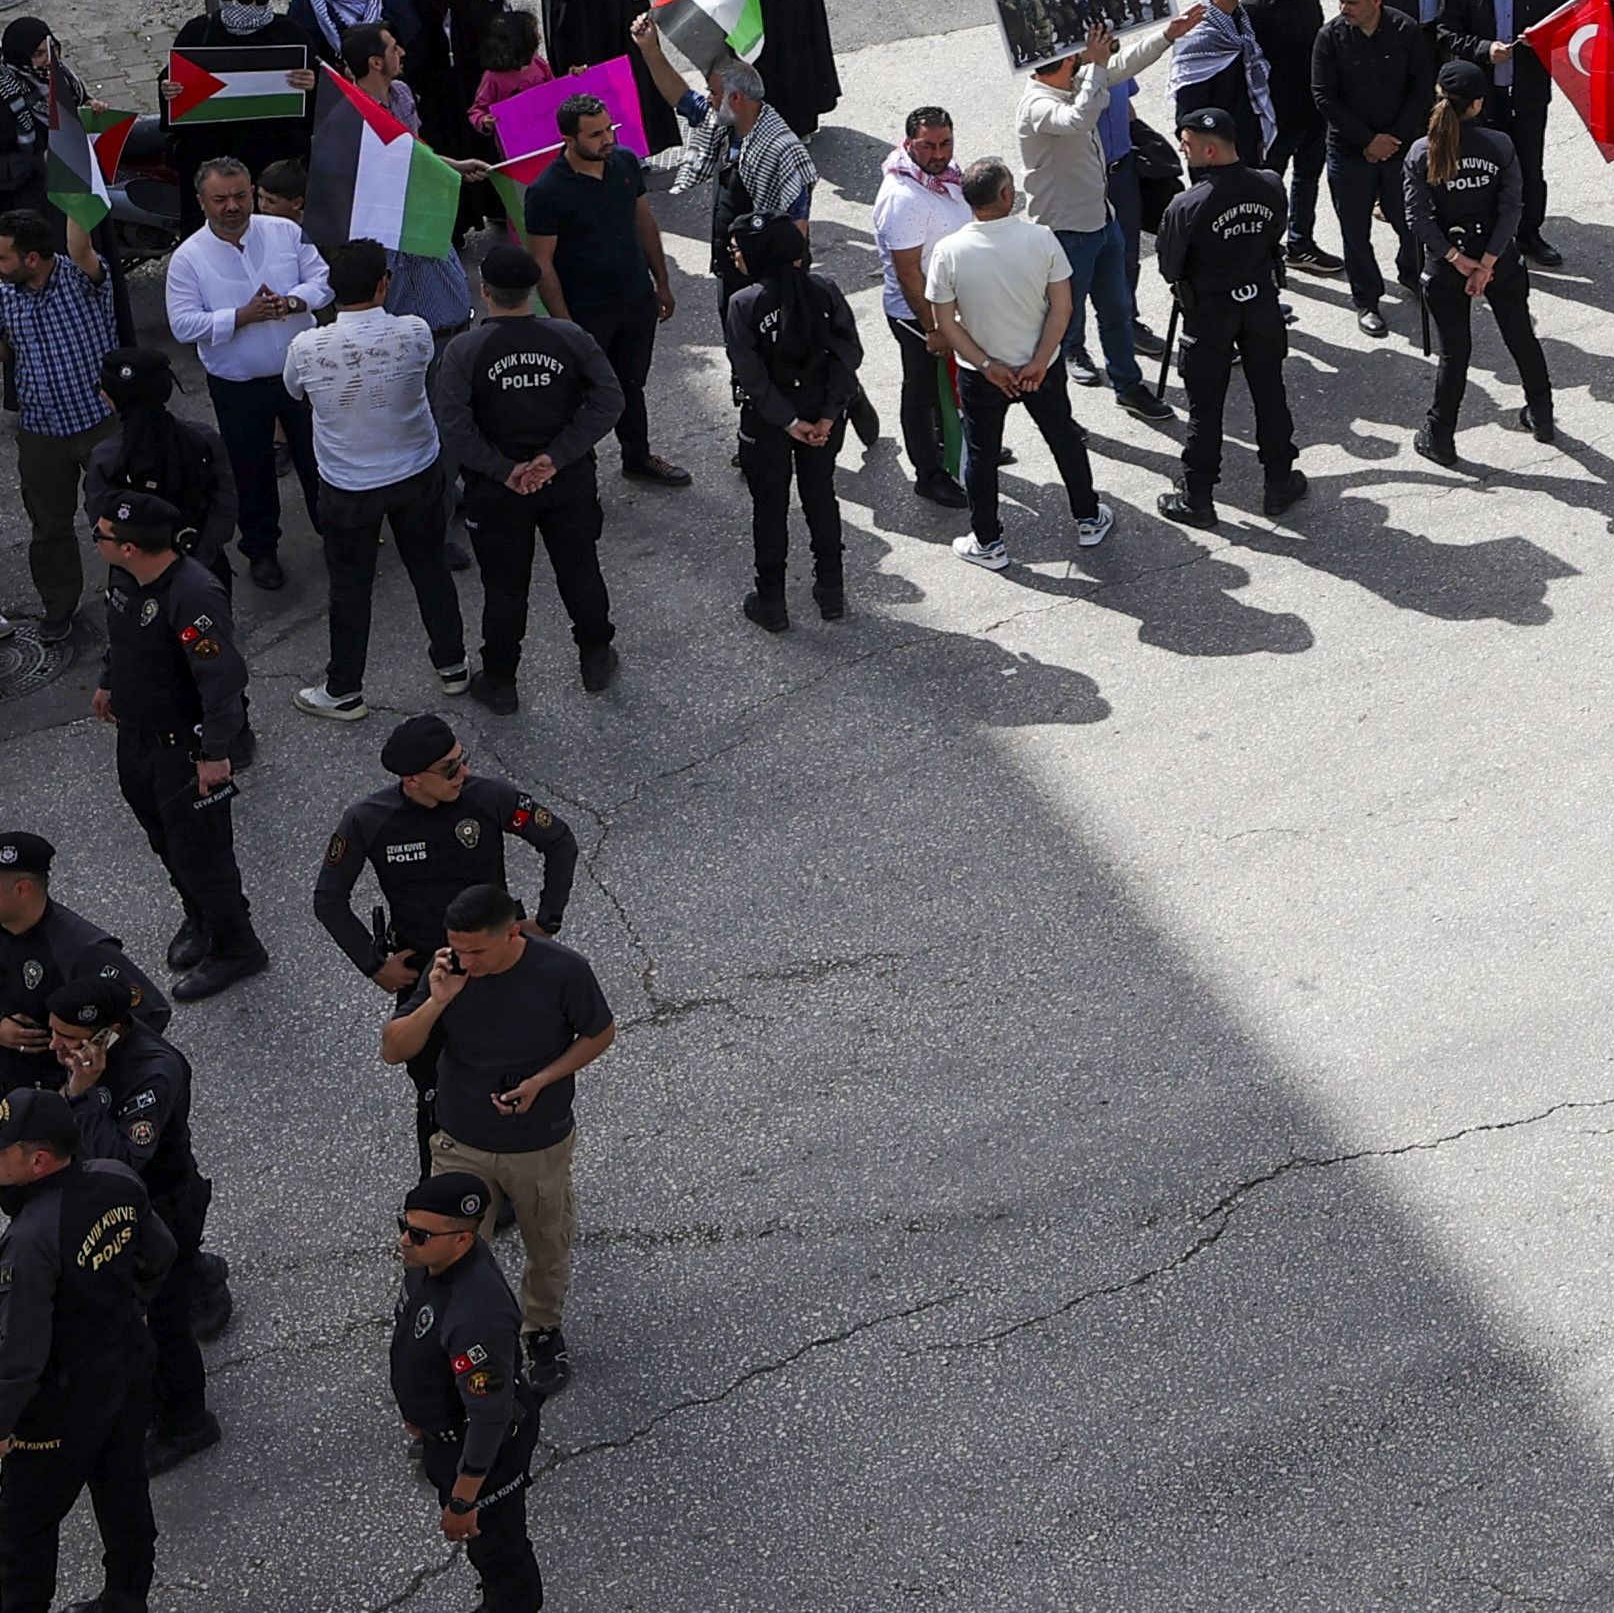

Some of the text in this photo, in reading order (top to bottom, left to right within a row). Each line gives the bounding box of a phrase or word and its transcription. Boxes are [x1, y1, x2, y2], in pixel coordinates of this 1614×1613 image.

[1462, 157, 1501, 176] KUVVET
[1239, 202, 1274, 222] KUVVET
[759, 308, 780, 334] ÇEV
[520, 352, 565, 376] KUVVET
